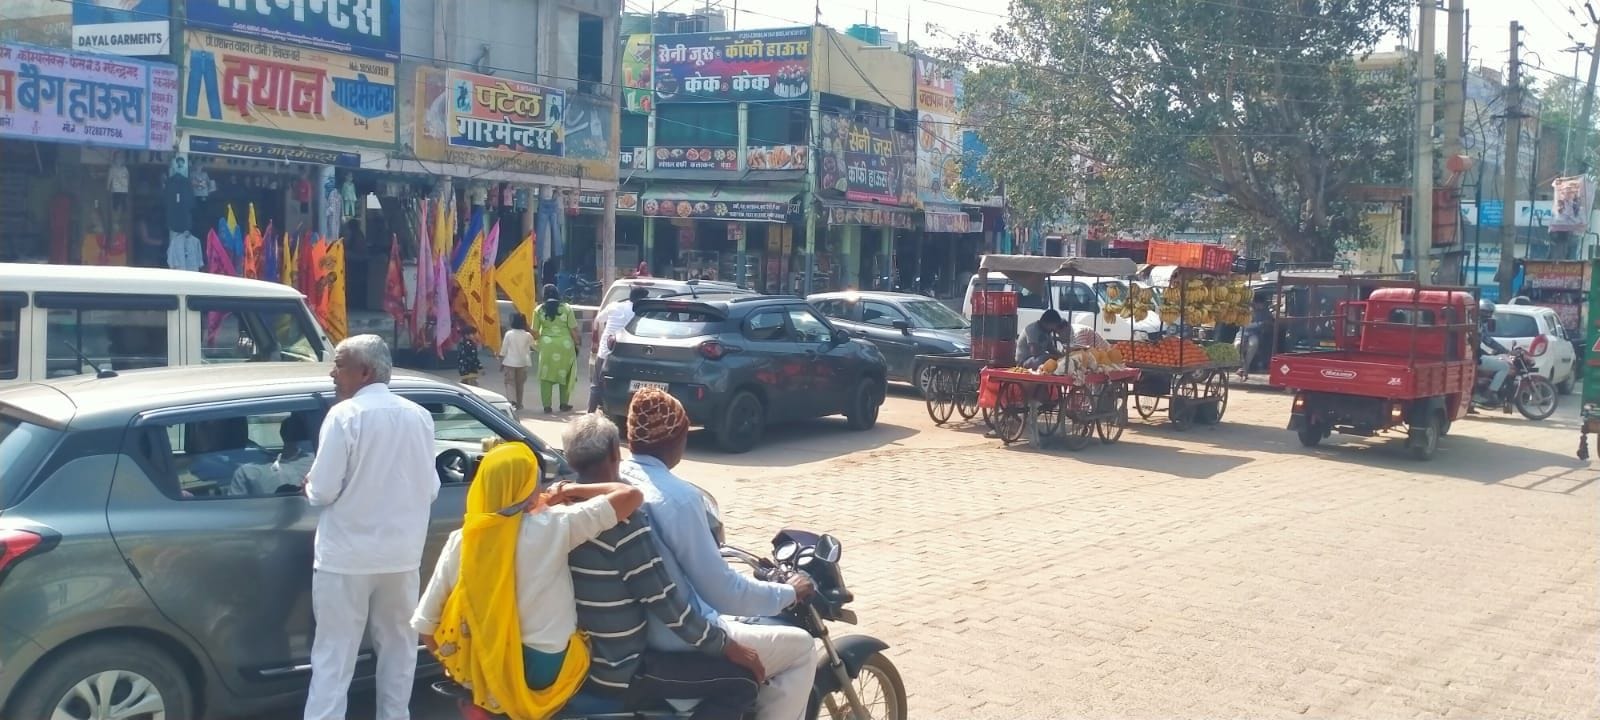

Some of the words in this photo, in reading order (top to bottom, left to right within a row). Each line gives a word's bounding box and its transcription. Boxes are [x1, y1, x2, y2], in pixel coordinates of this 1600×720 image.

[78, 34, 110, 47] DAYAL
[110, 33, 162, 46] GARMENTS
[658, 43, 687, 63] सैनी
[688, 45, 716, 66] जूस
[725, 39, 764, 58] कॉफी
[766, 41, 810, 57] हाऊस
[17, 63, 66, 117] बैग
[68, 79, 145, 124] हाऊस
[221, 53, 328, 121] दयाल
[684, 72, 722, 92] केक
[732, 70, 771, 92] केक
[475, 80, 544, 117] पटेल
[217, 143, 263, 155] दयाल
